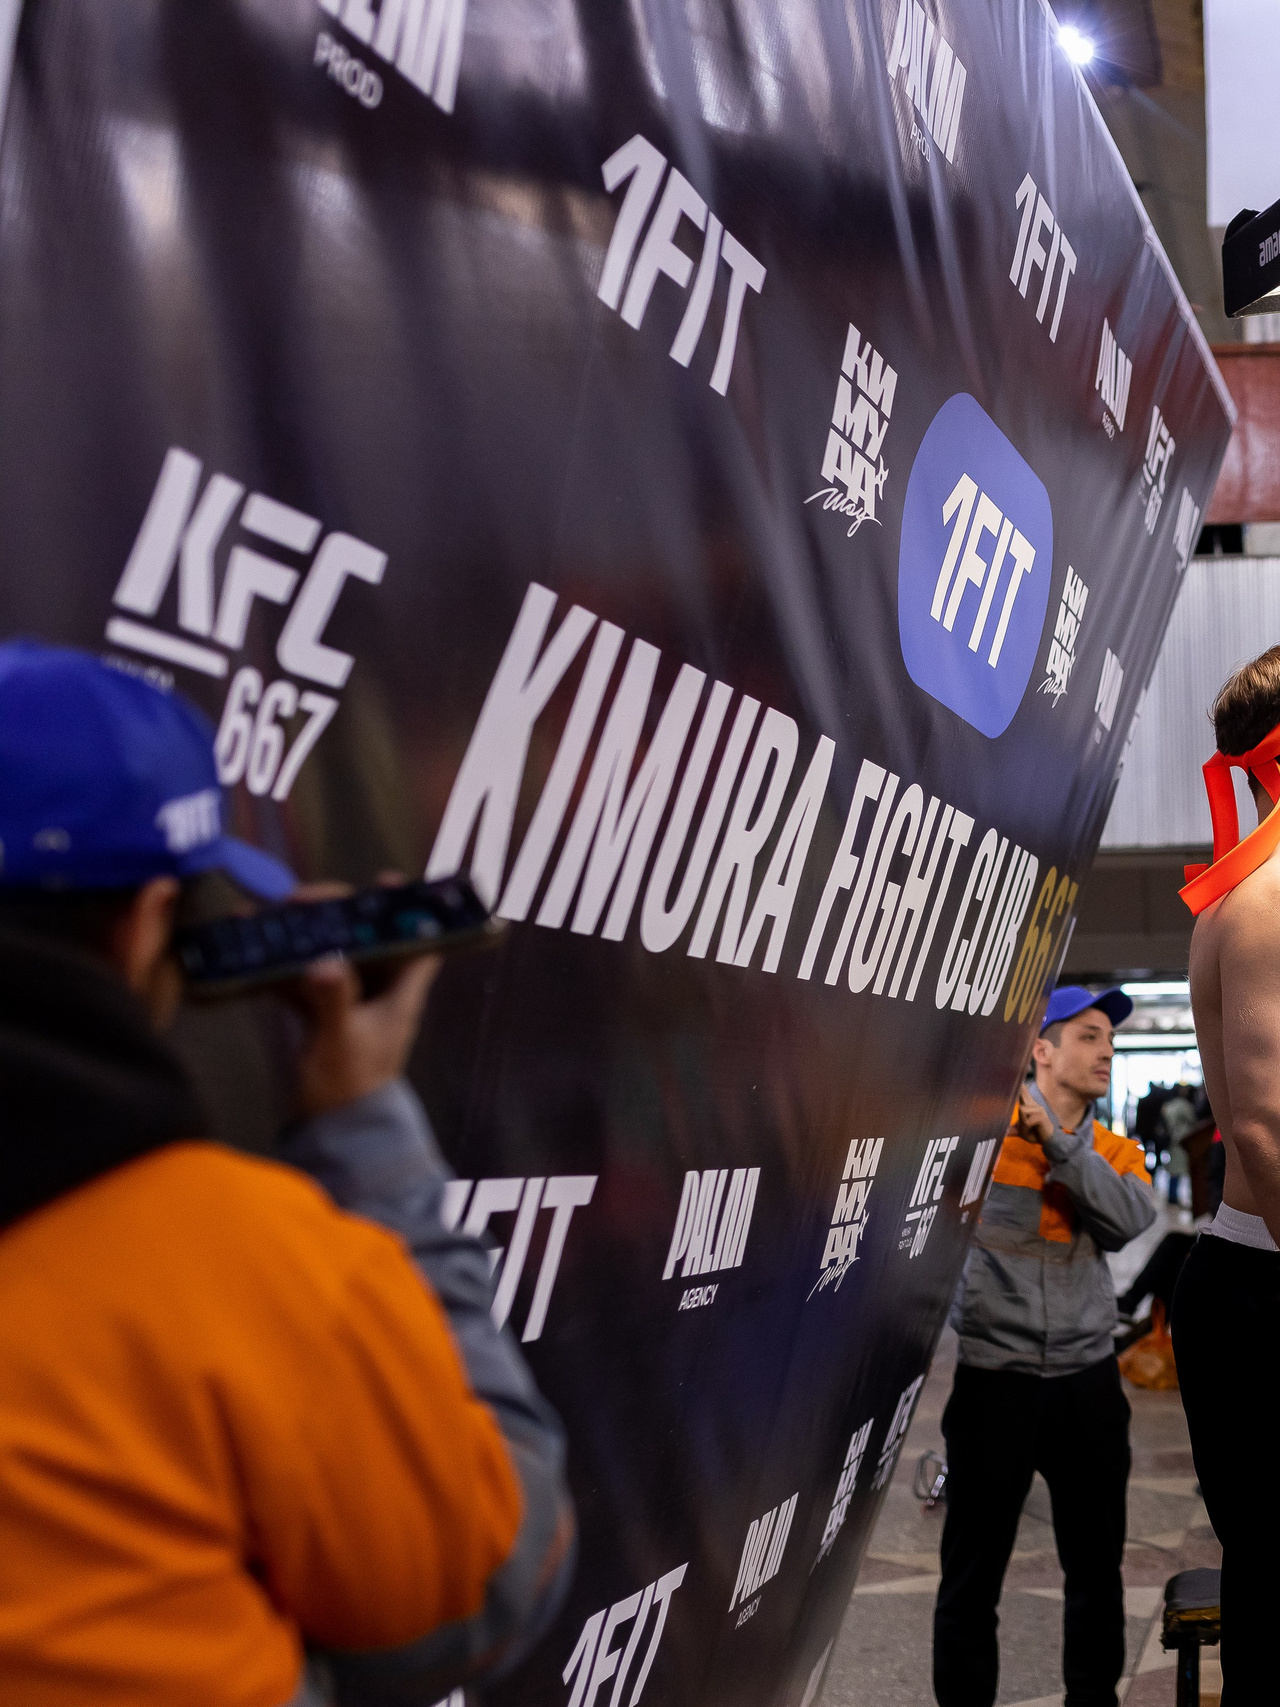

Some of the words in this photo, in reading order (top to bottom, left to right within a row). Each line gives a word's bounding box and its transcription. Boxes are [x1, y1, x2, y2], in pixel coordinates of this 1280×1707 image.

[313, 31, 384, 110] PROD
[597, 134, 767, 397] 1FIT
[1009, 173, 1078, 343] 1FIT
[112, 446, 389, 689] KFC
[930, 473, 1036, 669] 1FIT
[213, 666, 339, 801] 667
[424, 581, 836, 974] KIMURA
[797, 758, 975, 1002] FIGHT
[935, 827, 1039, 1017] CLUB
[909, 1136, 960, 1208] KFC
[678, 1283, 720, 1312] AGENCY
[562, 1562, 688, 1707] 1FIT
